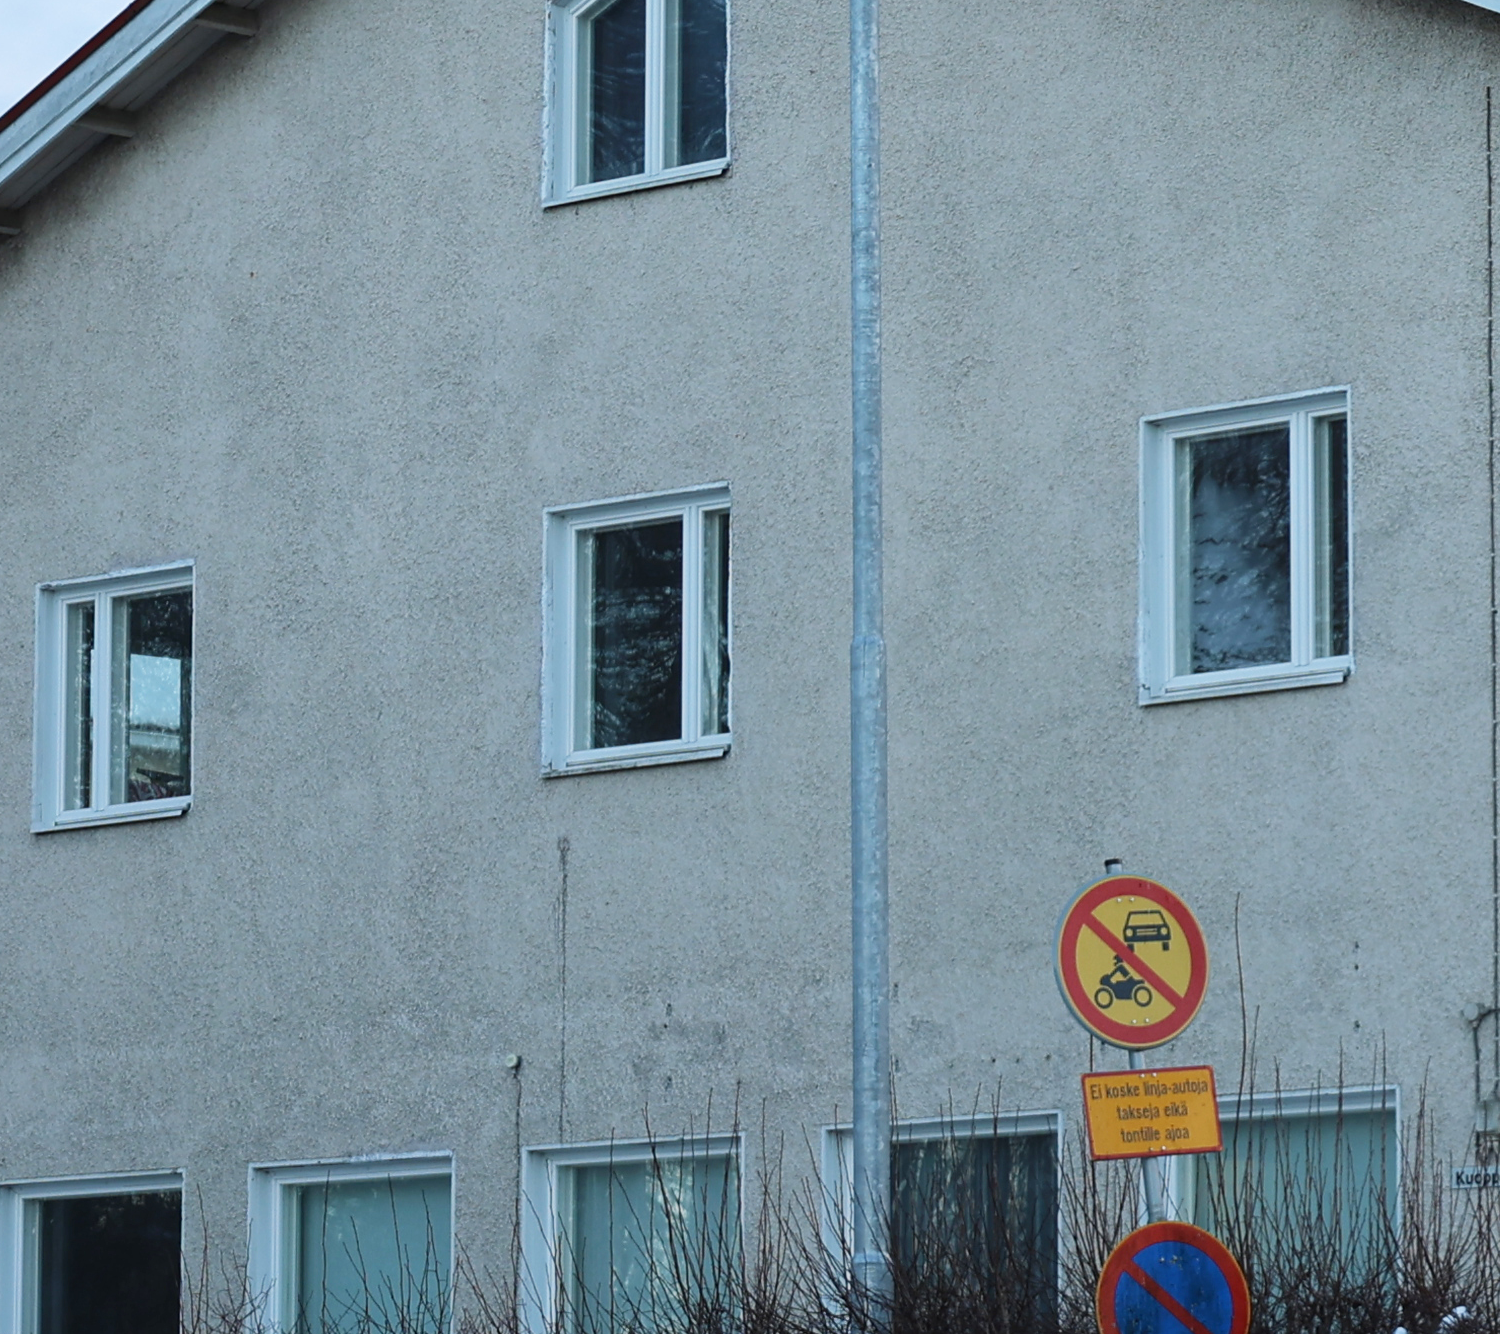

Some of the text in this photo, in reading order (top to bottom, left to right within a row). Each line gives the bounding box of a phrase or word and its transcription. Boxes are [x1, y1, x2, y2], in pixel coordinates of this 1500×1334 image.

[1090, 1078, 1208, 1100] Ei koske linja-autoja
[1116, 1101, 1188, 1120] takseja eikä
[1121, 1125, 1189, 1142] tontille ajoa
